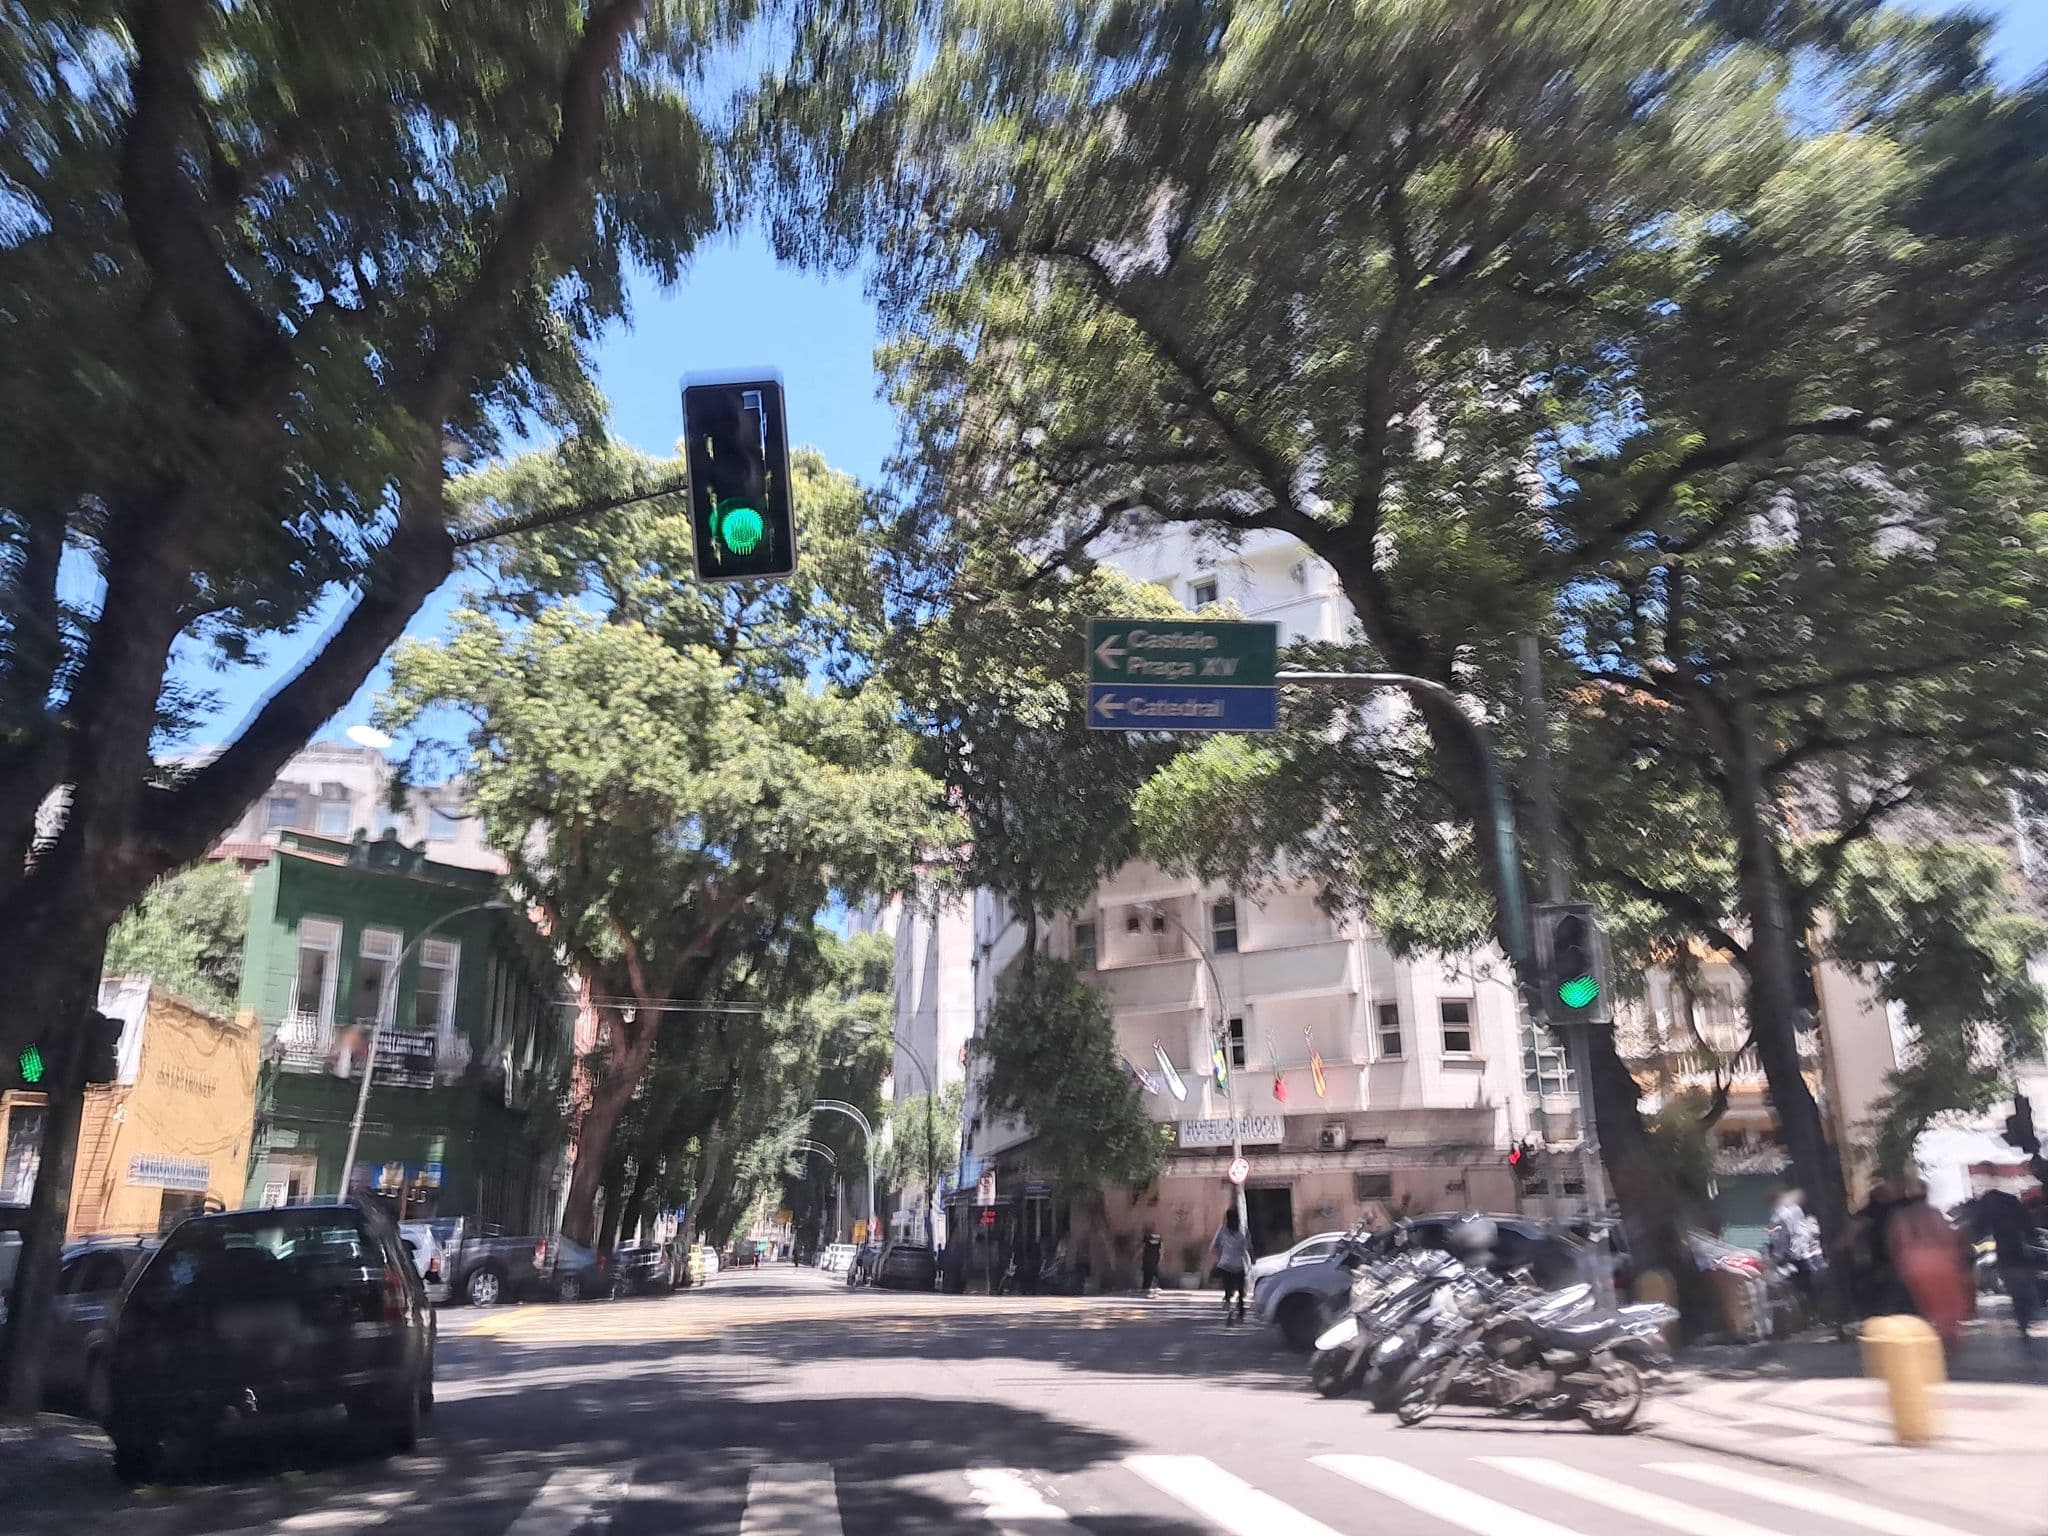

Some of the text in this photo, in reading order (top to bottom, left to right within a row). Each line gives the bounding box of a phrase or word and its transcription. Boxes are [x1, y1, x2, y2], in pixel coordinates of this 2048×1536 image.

[1127, 629, 1218, 649] Castelo
[1127, 657, 1239, 679] Praça XV
[1126, 697, 1225, 717] Catedral
[1184, 1119, 1223, 1141] HOTEL
